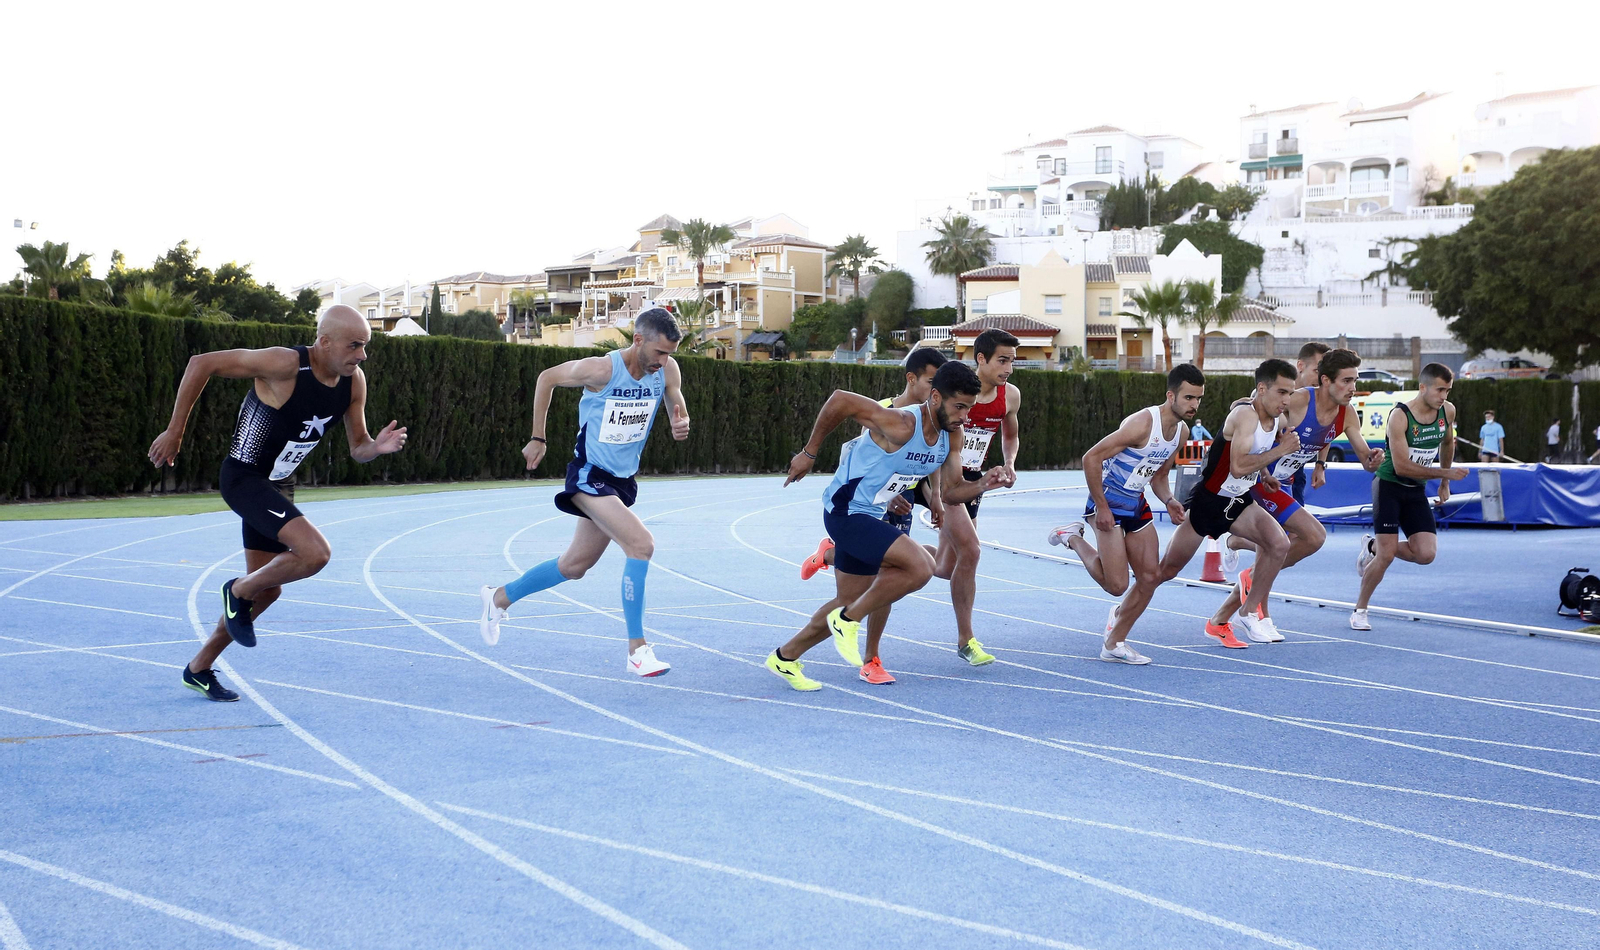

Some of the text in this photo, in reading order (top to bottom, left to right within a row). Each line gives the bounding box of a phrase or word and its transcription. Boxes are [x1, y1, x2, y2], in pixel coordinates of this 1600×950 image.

[611, 385, 652, 400] nerja
[617, 410, 649, 426] Fernández
[640, 423, 646, 431] 2
[905, 451, 935, 465] nerja
[1147, 448, 1169, 458] aula
[887, 482, 897, 493] B.
[624, 575, 634, 602] SSP
